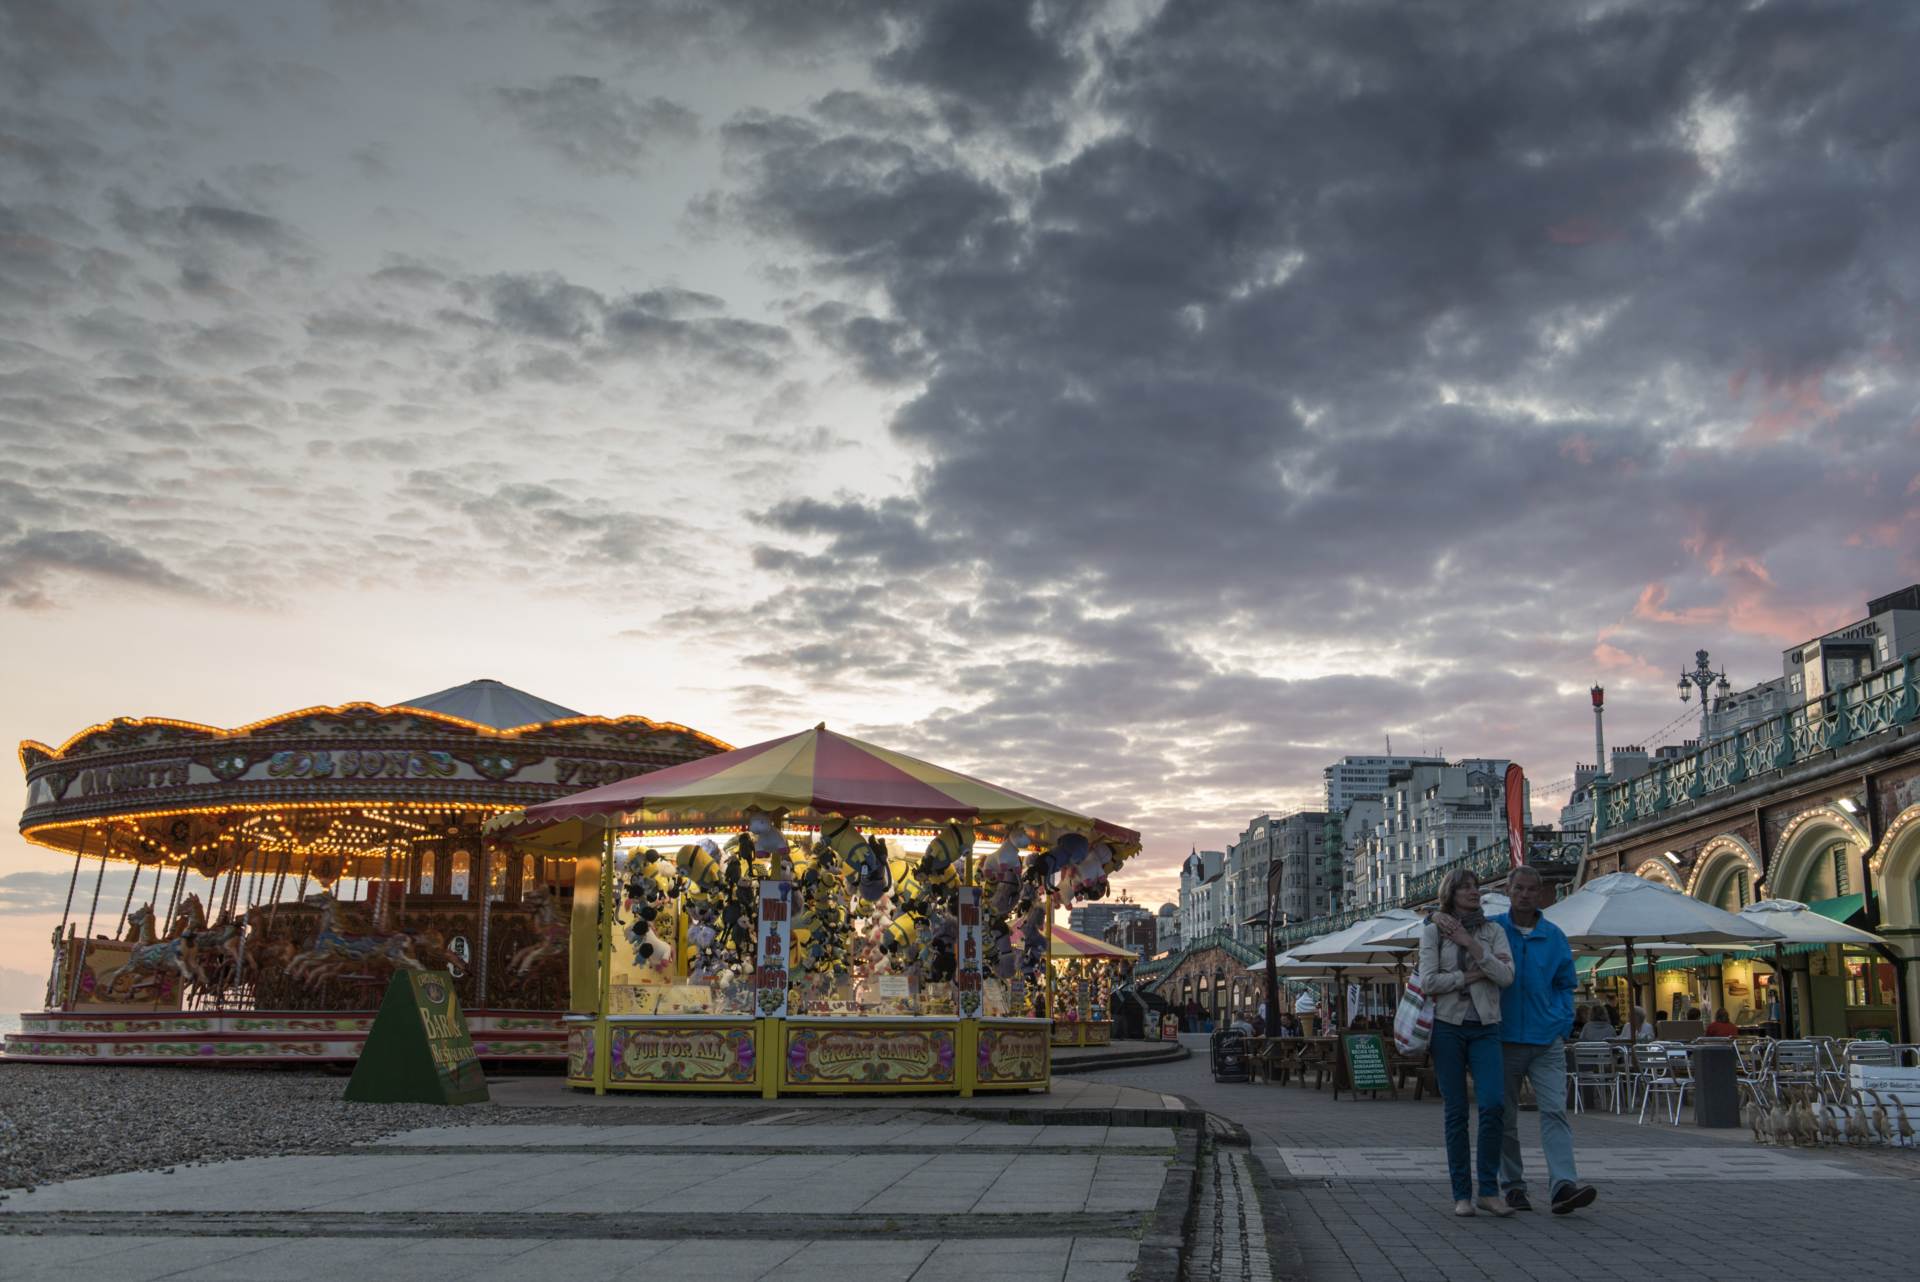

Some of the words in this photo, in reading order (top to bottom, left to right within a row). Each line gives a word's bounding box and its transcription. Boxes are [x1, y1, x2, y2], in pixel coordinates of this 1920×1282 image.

[633, 1041, 659, 1061] FUN
[661, 1041, 692, 1058] FOR
[695, 1040, 725, 1062] ALL
[820, 1044, 874, 1065] GREAT
[879, 1043, 930, 1064] GAMES
